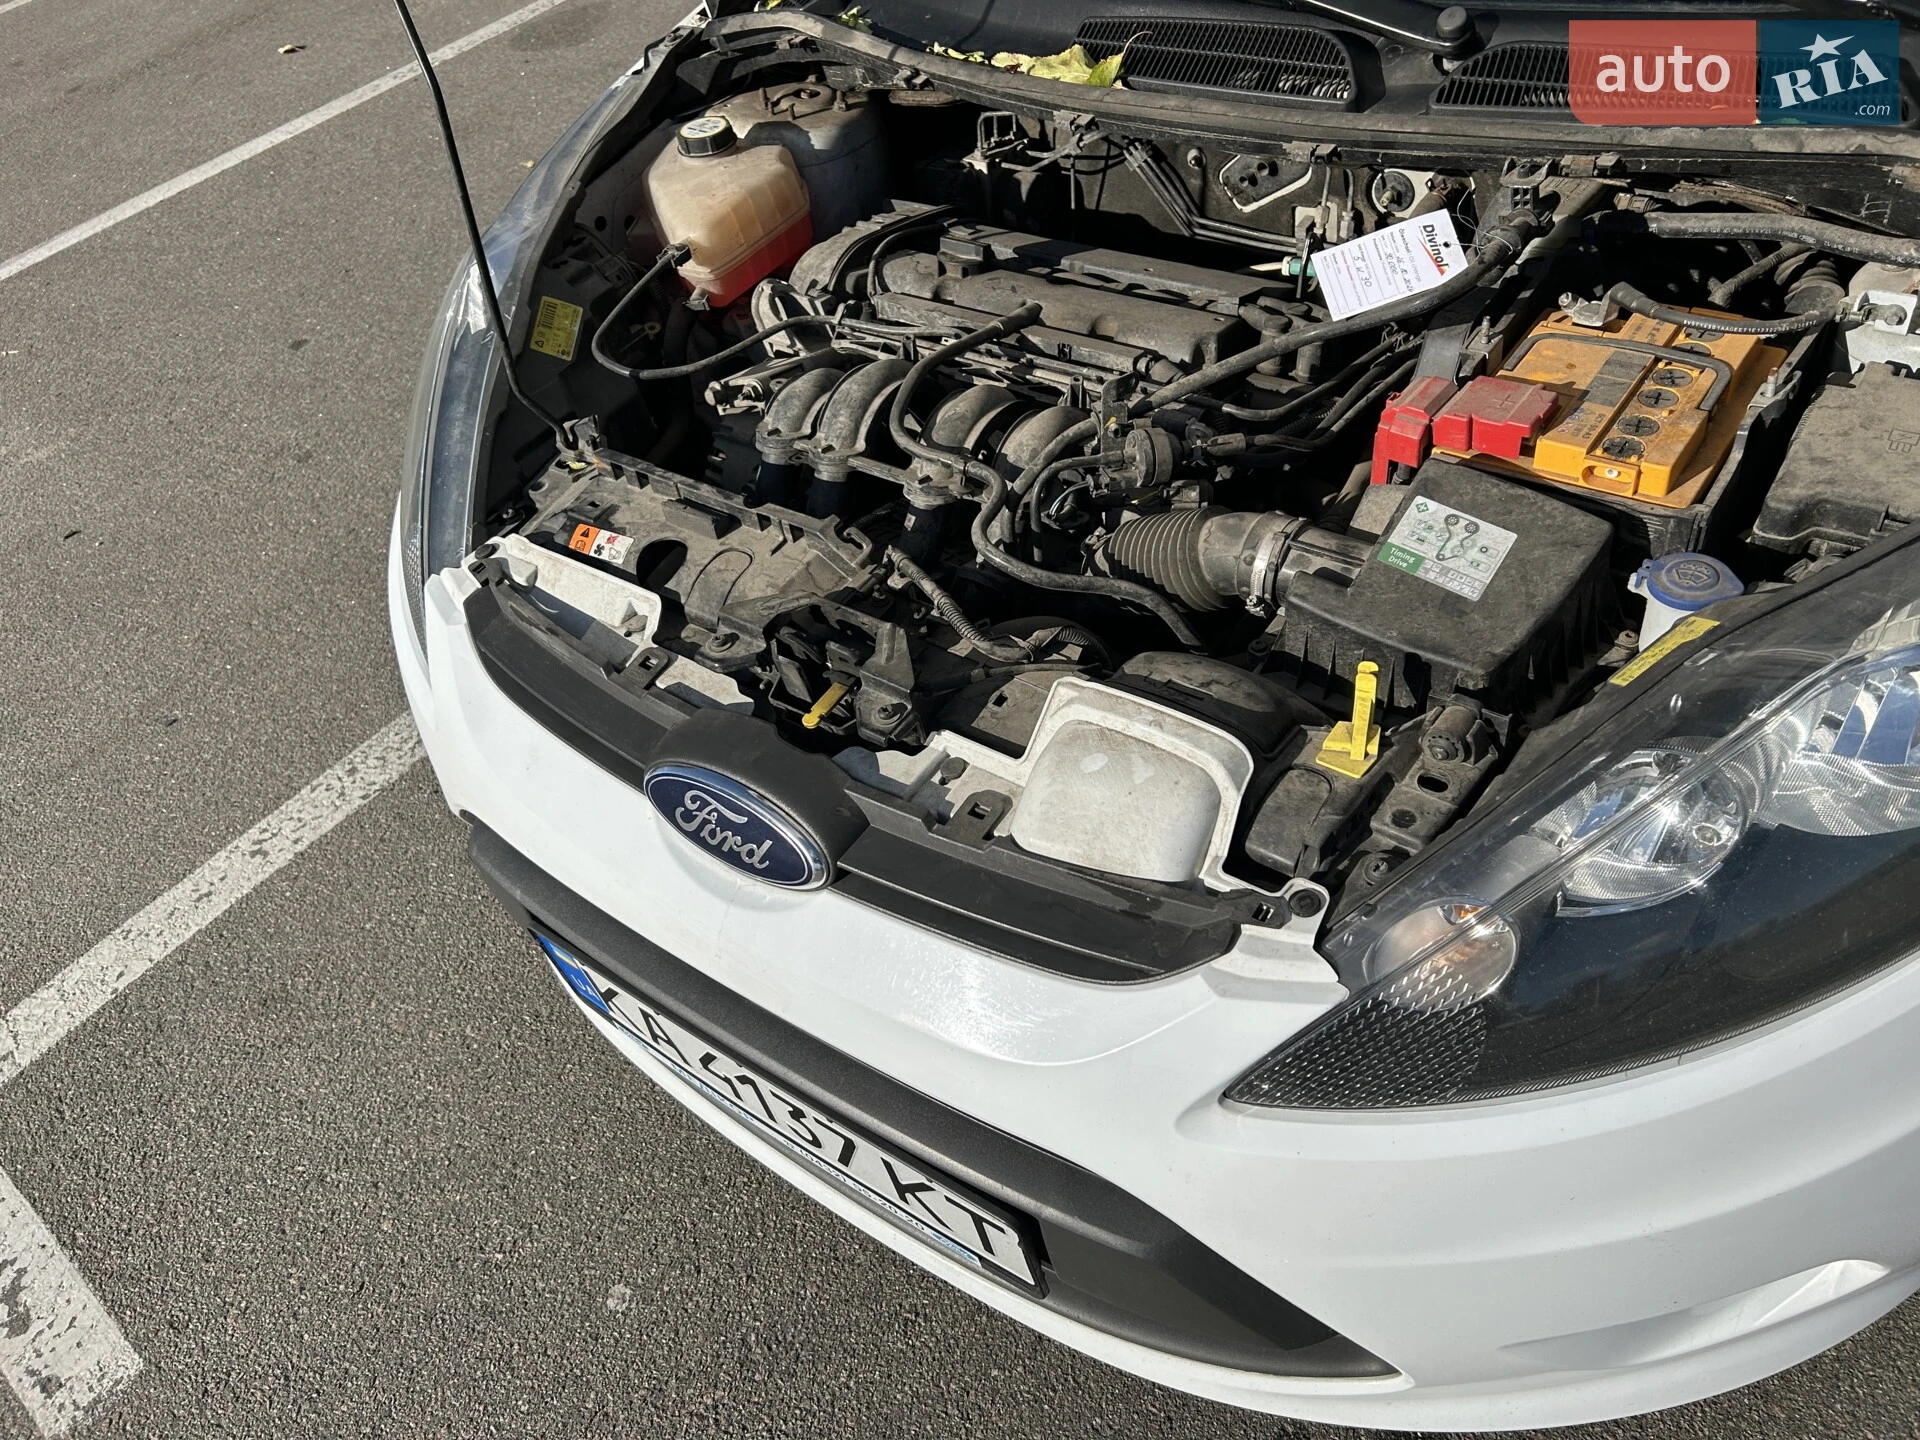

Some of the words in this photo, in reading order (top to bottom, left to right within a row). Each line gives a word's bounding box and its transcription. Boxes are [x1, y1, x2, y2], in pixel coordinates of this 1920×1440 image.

[1422, 224, 1450, 267] Divinol
[1388, 555, 1408, 568] Drive
[1390, 547, 1416, 564] Timing
[674, 790, 773, 869] Ford
[799, 1148, 848, 1182] (0432)
